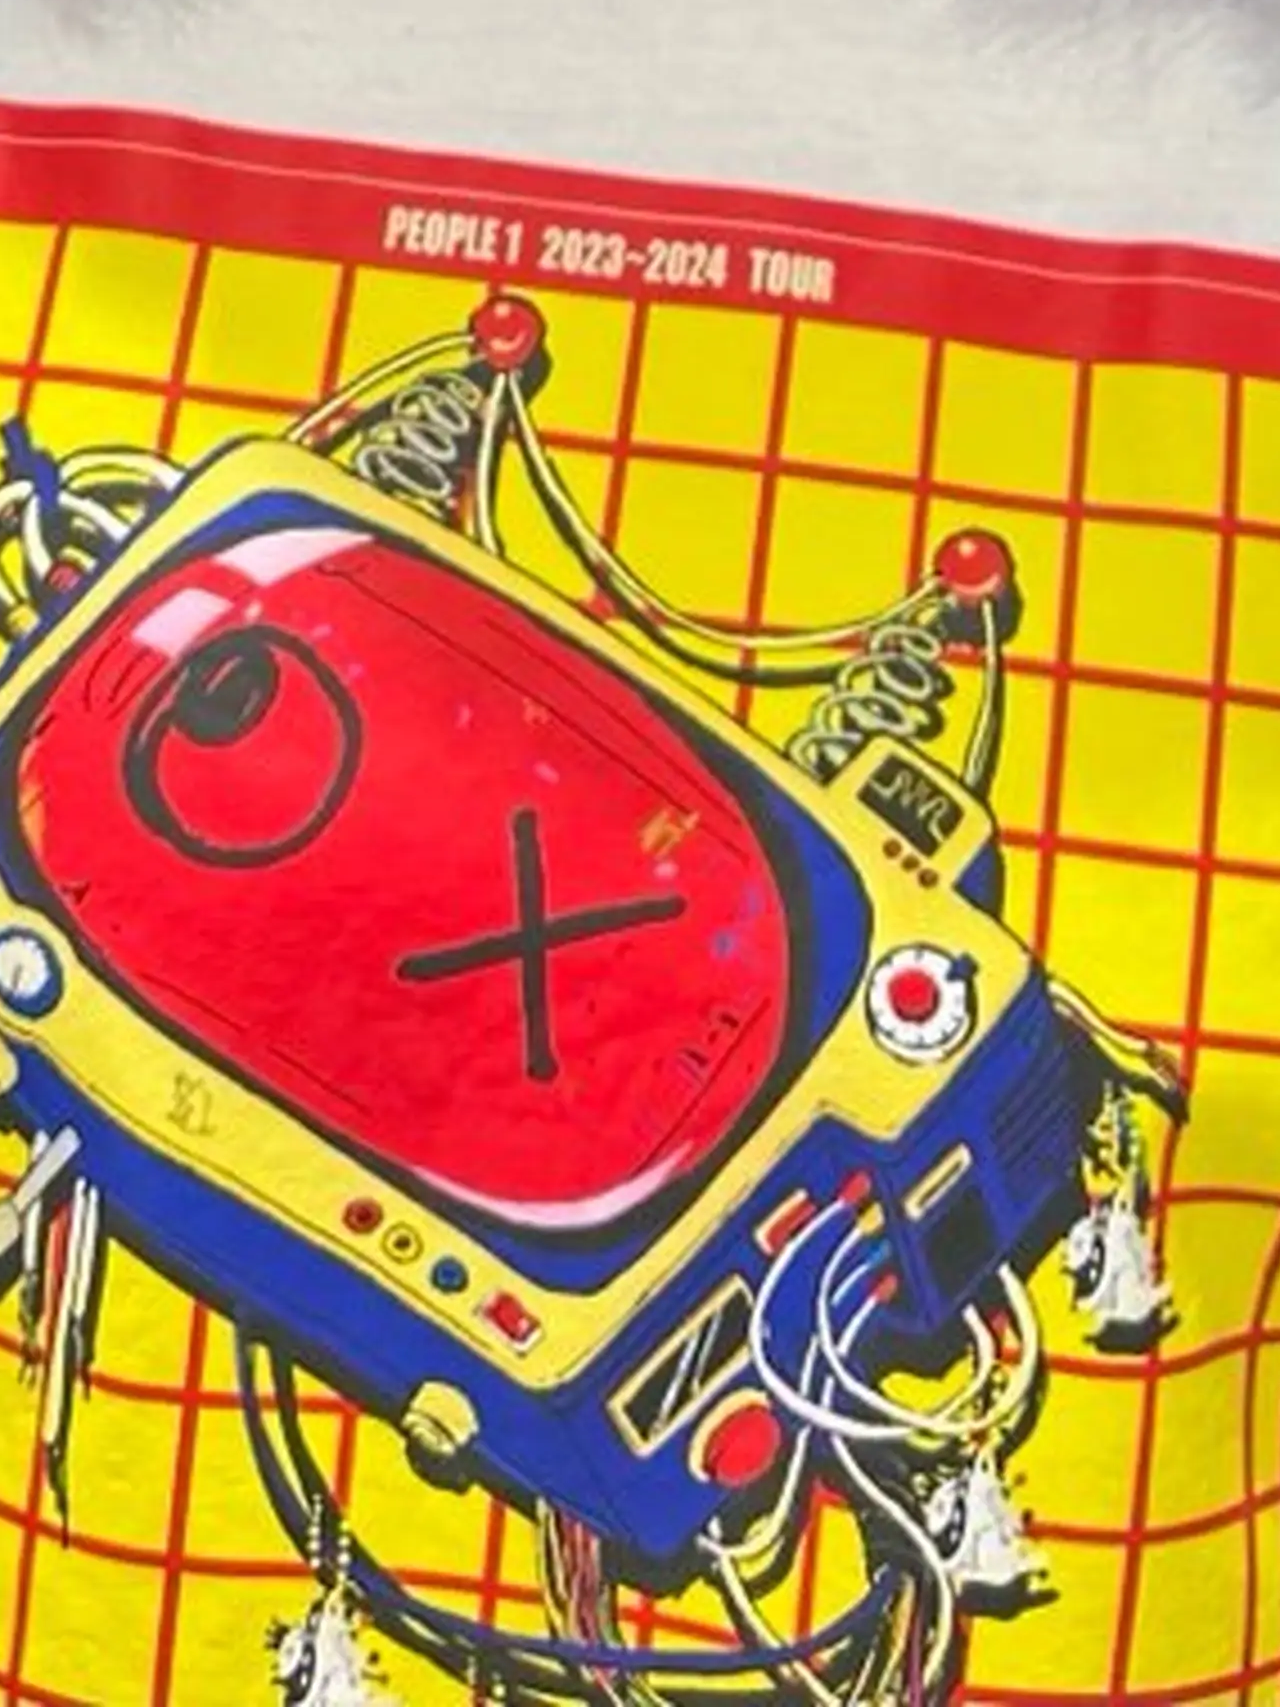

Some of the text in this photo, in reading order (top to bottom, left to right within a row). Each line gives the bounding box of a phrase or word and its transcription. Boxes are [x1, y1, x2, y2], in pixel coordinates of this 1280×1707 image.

[383, 204, 500, 262] PEOPLE
[505, 221, 523, 266] 1
[750, 246, 836, 304] TOUR
